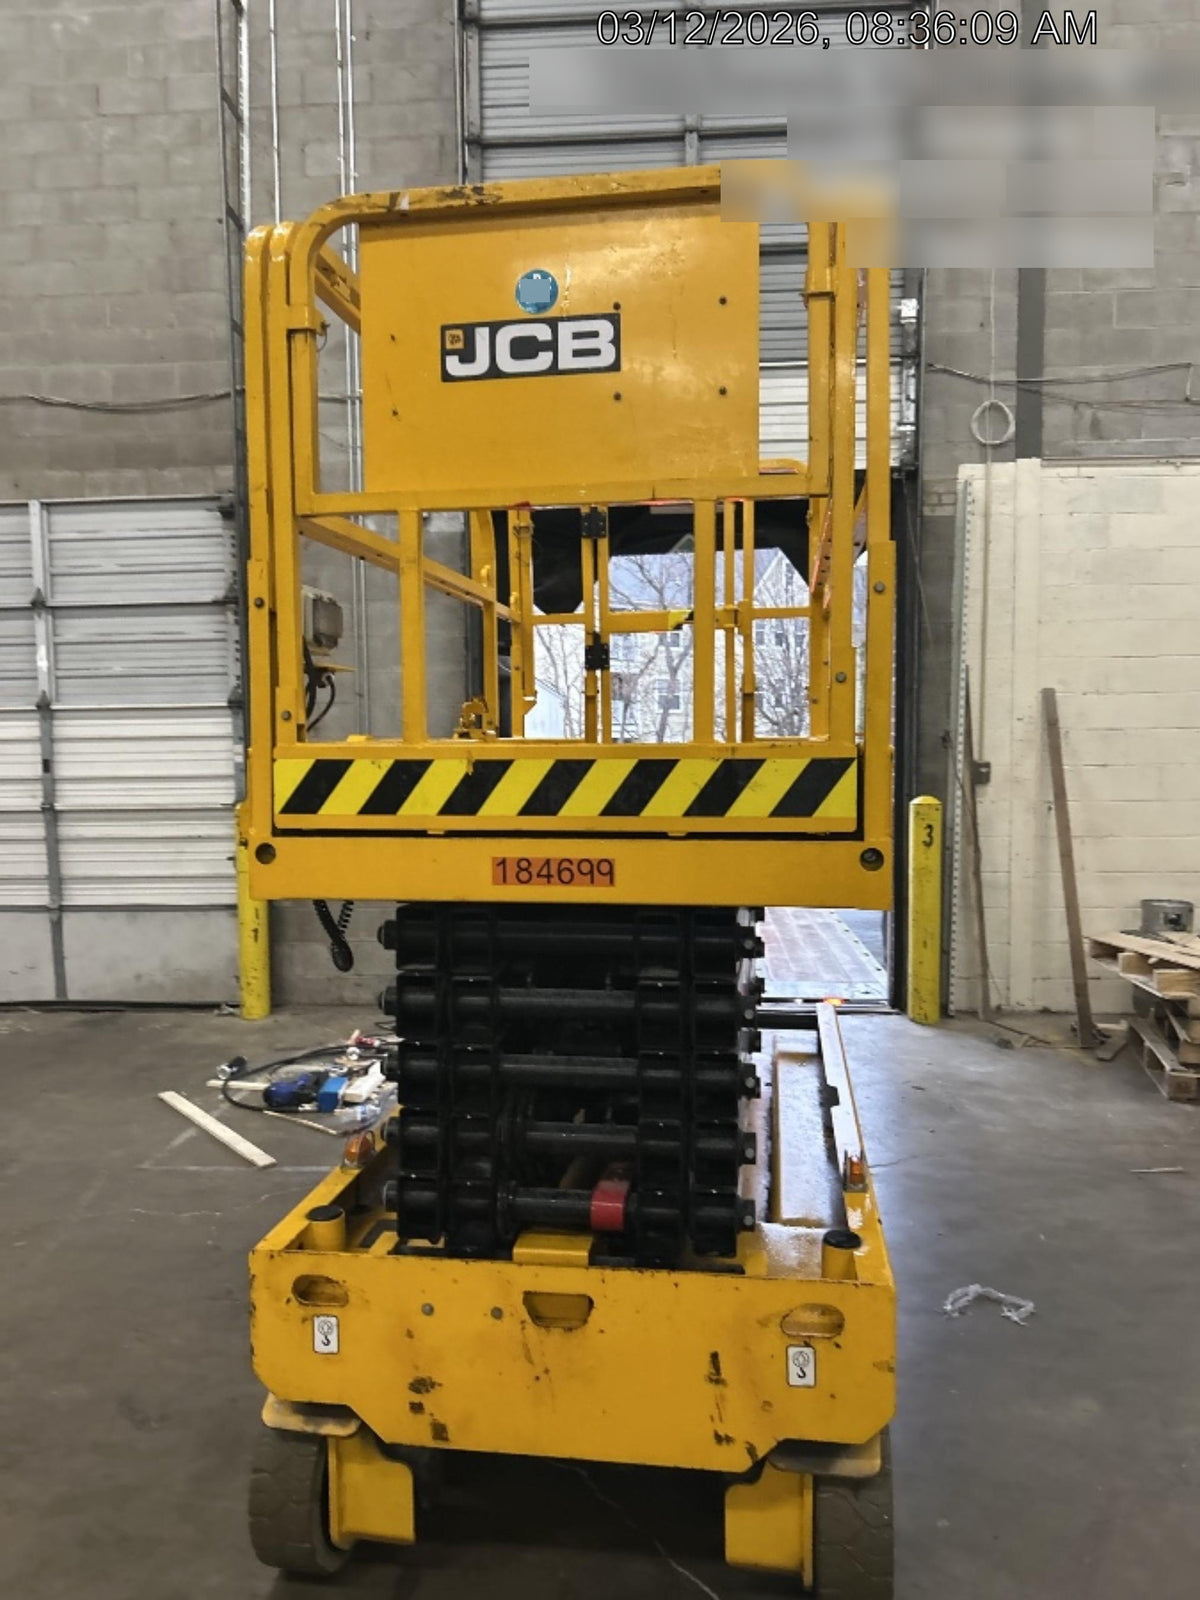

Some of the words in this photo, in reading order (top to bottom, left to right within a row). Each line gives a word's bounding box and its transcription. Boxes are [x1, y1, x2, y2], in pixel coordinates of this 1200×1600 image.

[445, 319, 617, 377] JCB
[922, 824, 934, 848] 3
[495, 857, 615, 885] 184699
